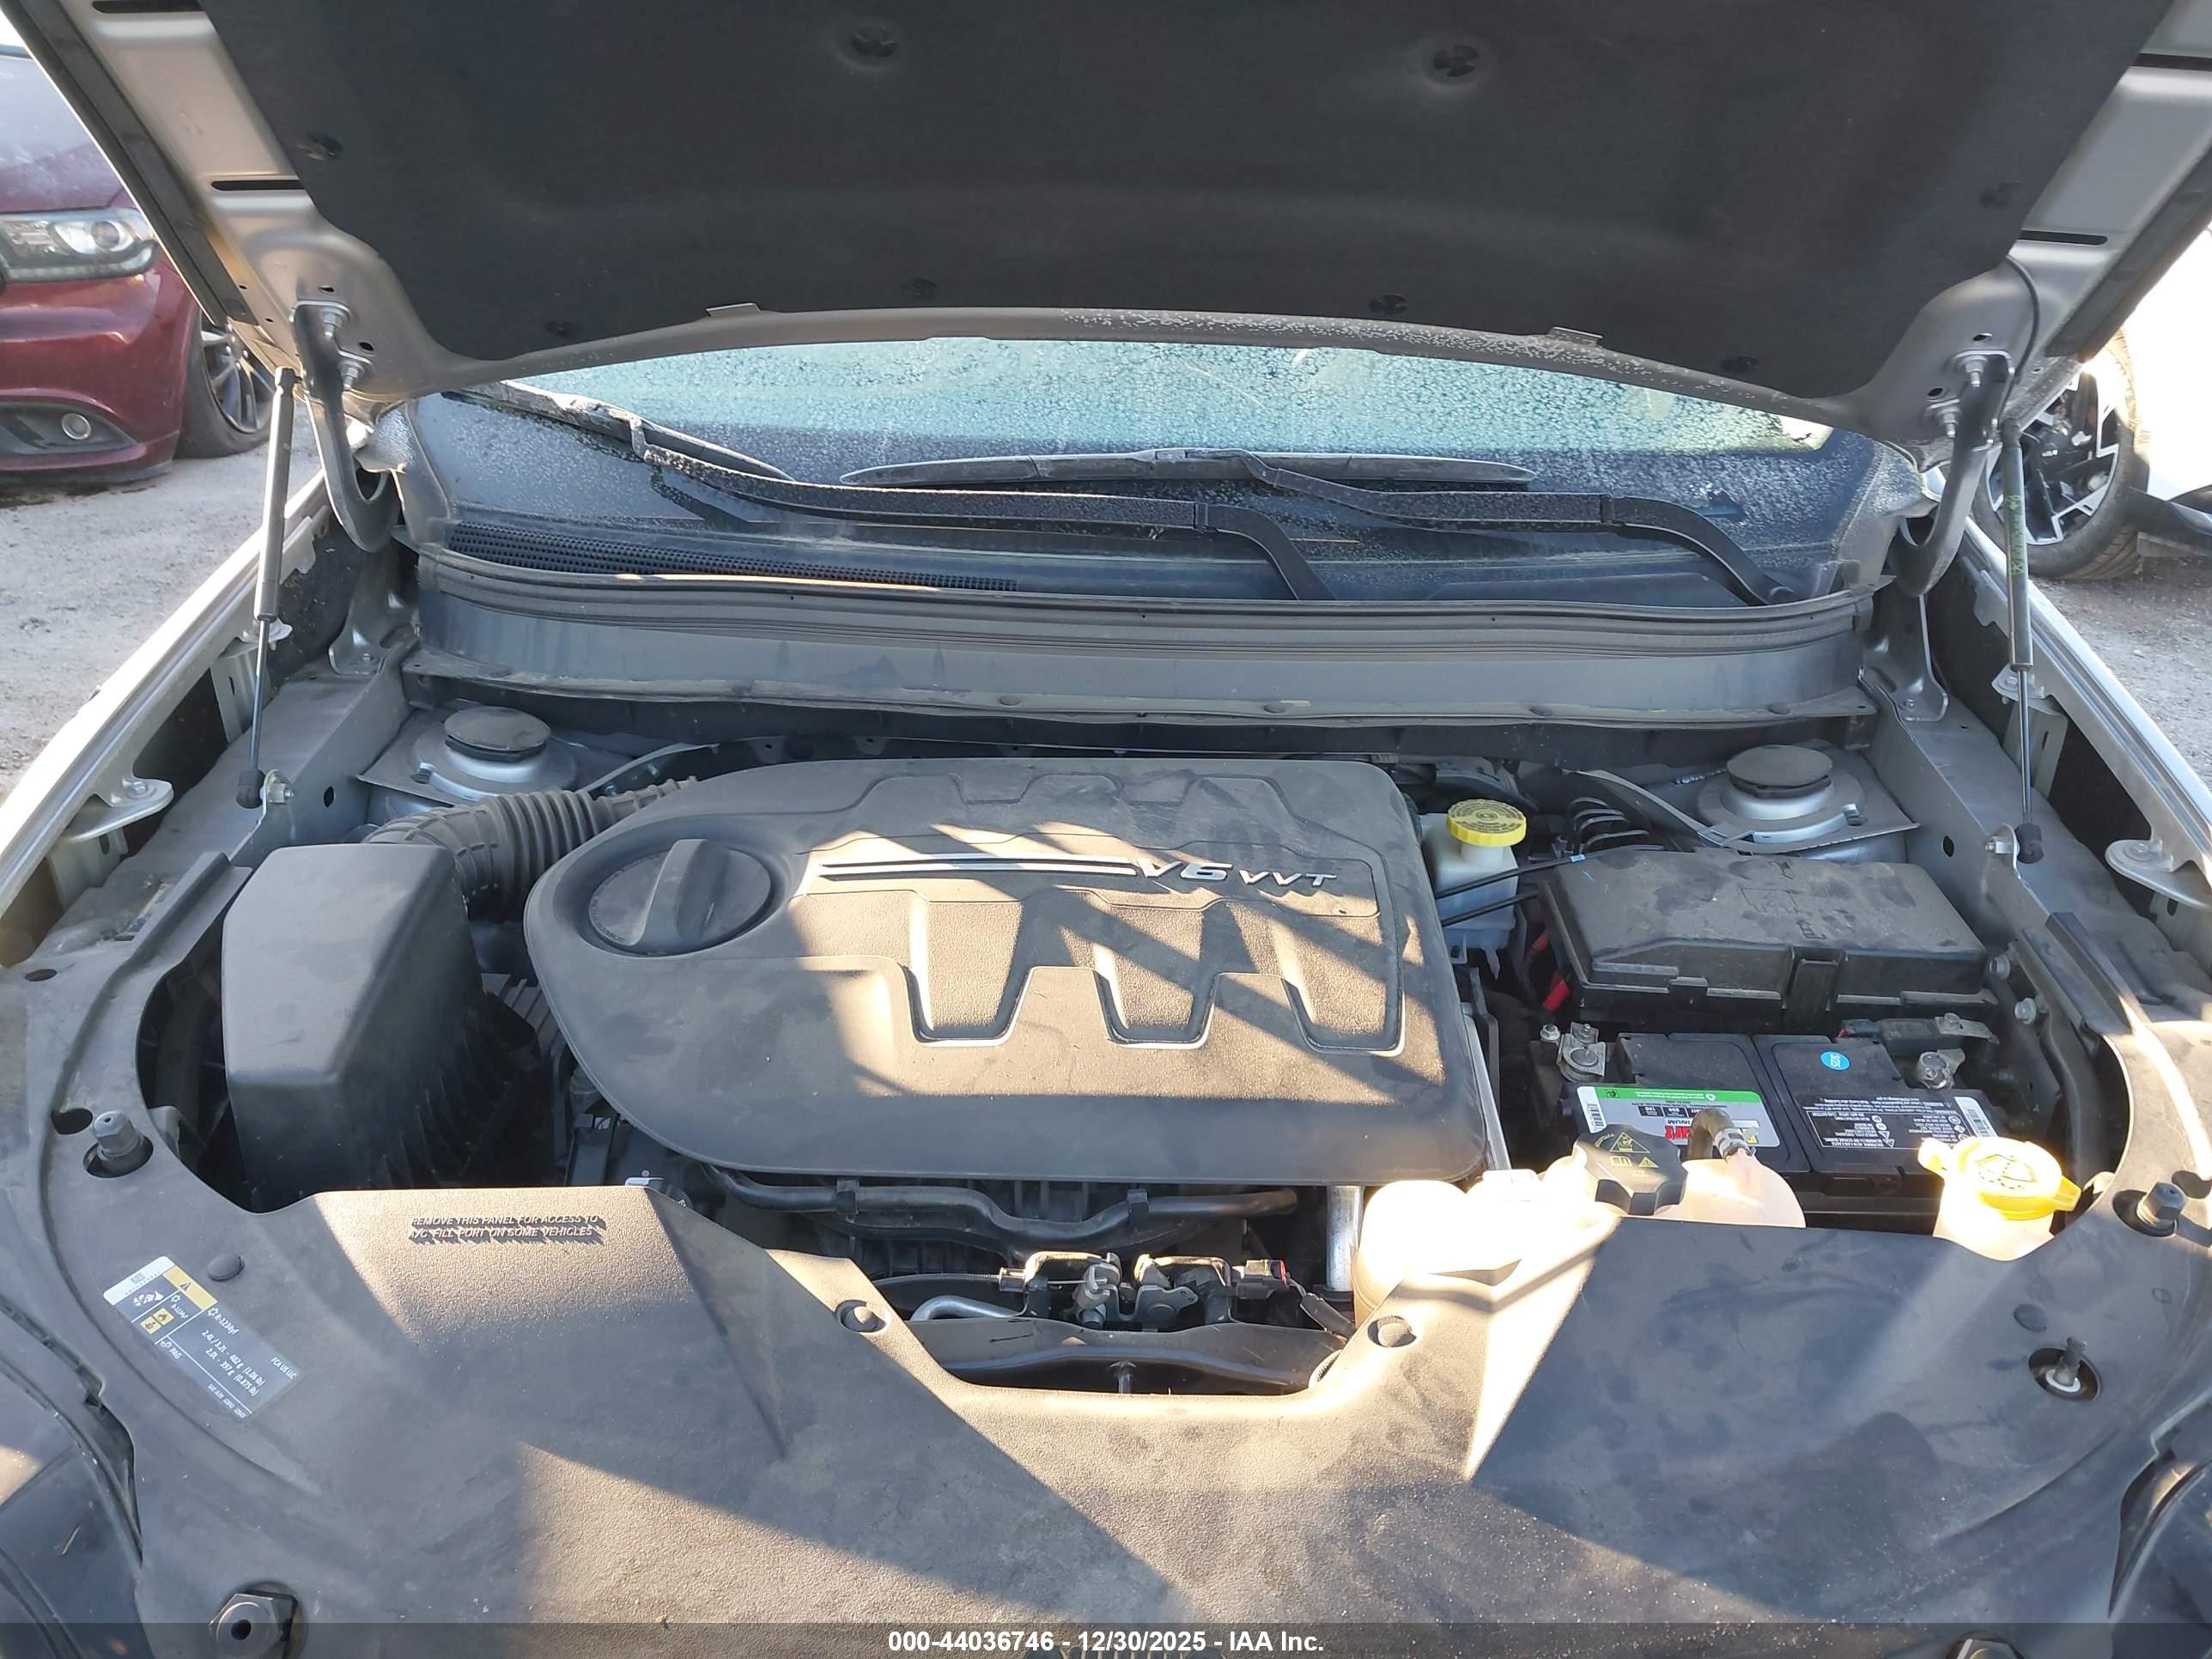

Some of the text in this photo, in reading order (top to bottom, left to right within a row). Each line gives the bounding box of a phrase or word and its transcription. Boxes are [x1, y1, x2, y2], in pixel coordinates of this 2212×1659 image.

[1138, 860, 1337, 887] V6 VVT
[411, 1215, 599, 1225] REMOVE THIS PANEL FOR ACCESS TO
[432, 1228, 454, 1238] FILL
[458, 1227, 484, 1237] PORT
[489, 1227, 505, 1237] ON
[507, 1227, 539, 1237] SOME
[542, 1226, 593, 1237] VEHICLES
[214, 1313, 240, 1335] R-1234yf
